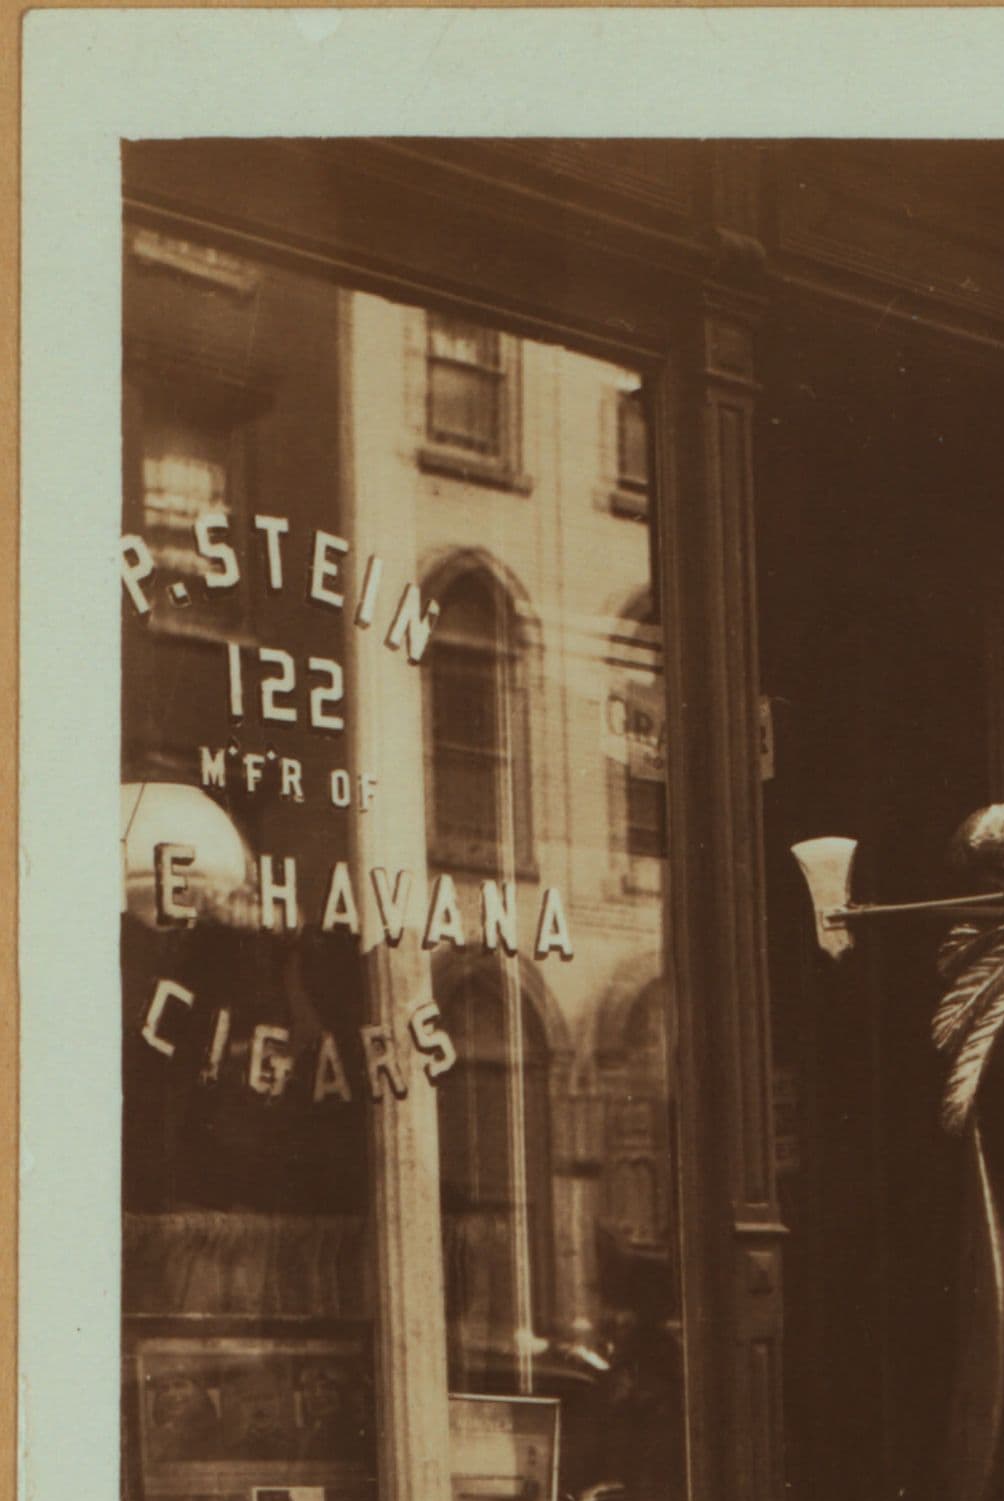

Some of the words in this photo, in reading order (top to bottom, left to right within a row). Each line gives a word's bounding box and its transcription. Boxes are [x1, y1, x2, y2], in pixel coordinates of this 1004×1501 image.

[229, 642, 343, 729] 122
[331, 769, 378, 813] OF
[260, 855, 574, 960] HAVANA
[141, 980, 457, 1103] CIGARS
